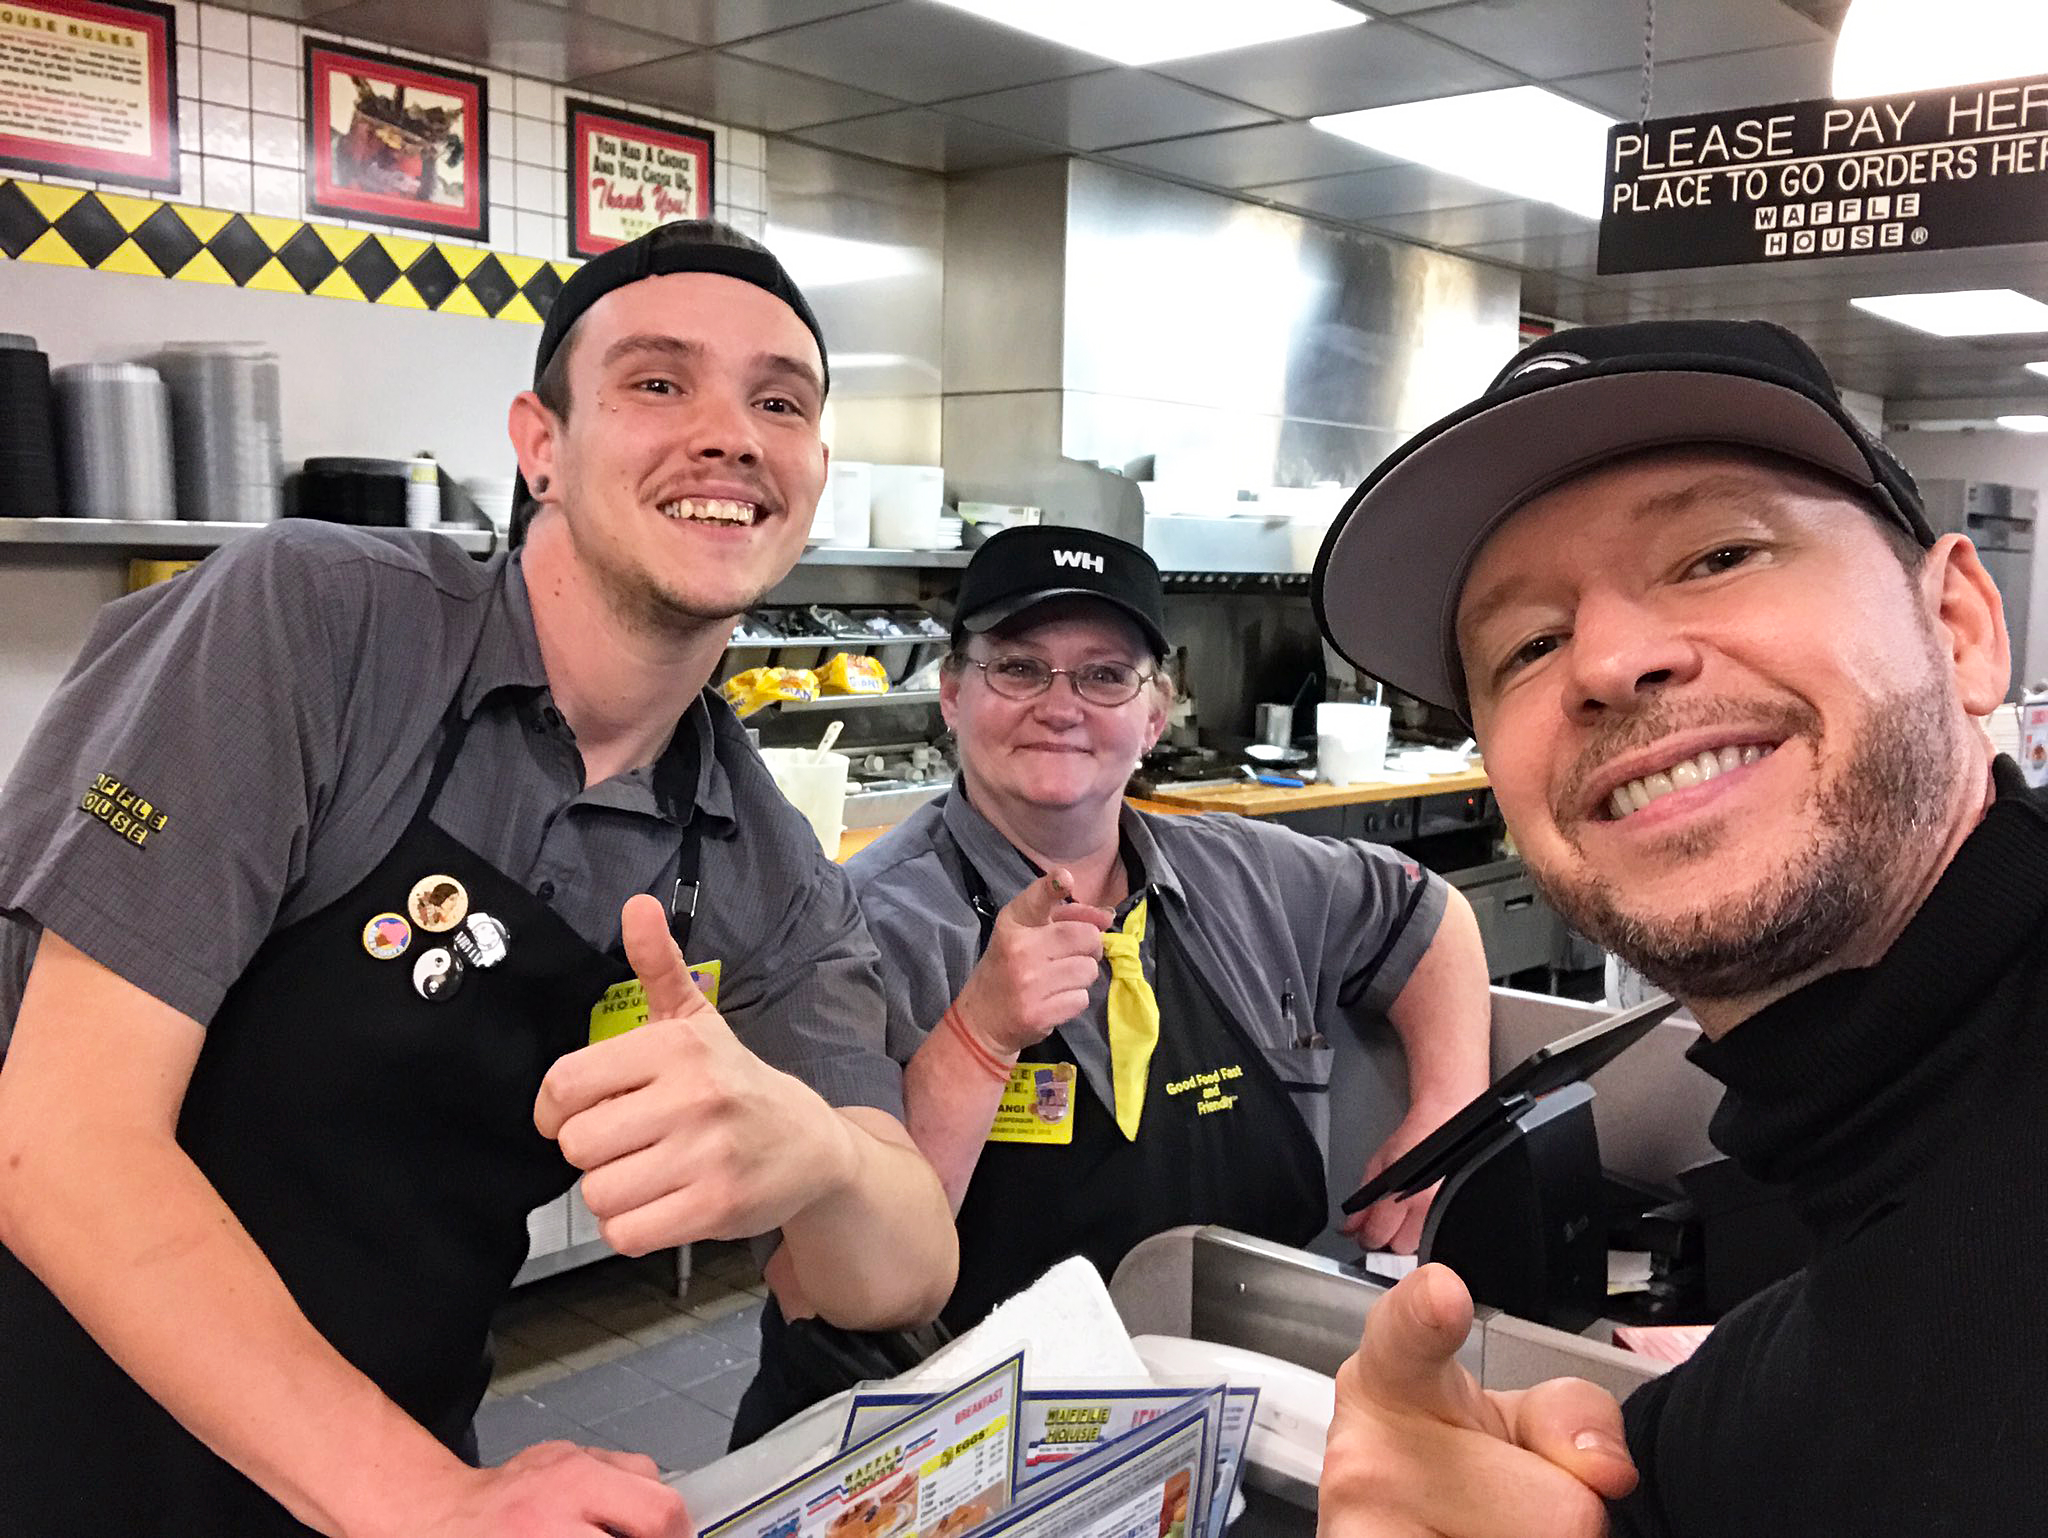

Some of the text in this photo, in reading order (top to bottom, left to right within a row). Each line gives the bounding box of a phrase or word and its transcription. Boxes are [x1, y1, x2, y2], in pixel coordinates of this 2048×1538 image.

[1614, 114, 1796, 174] PLEASE
[1823, 99, 1917, 150] PAY
[592, 177, 645, 212] Thank
[1613, 173, 1714, 215] PLACE
[1725, 168, 1768, 202] TO
[1779, 162, 1826, 198] GO
[1837, 145, 1979, 192] ORDERS
[1755, 192, 1920, 231] WAFFLE
[1764, 222, 1904, 257] HOUSE
[1053, 549, 1104, 574] WH
[1166, 1064, 1244, 1096] Good Food Fast
[1202, 1083, 1221, 1099] and
[1046, 1406, 1112, 1425] WAFFLE
[1046, 1424, 1101, 1443] HOUSE
